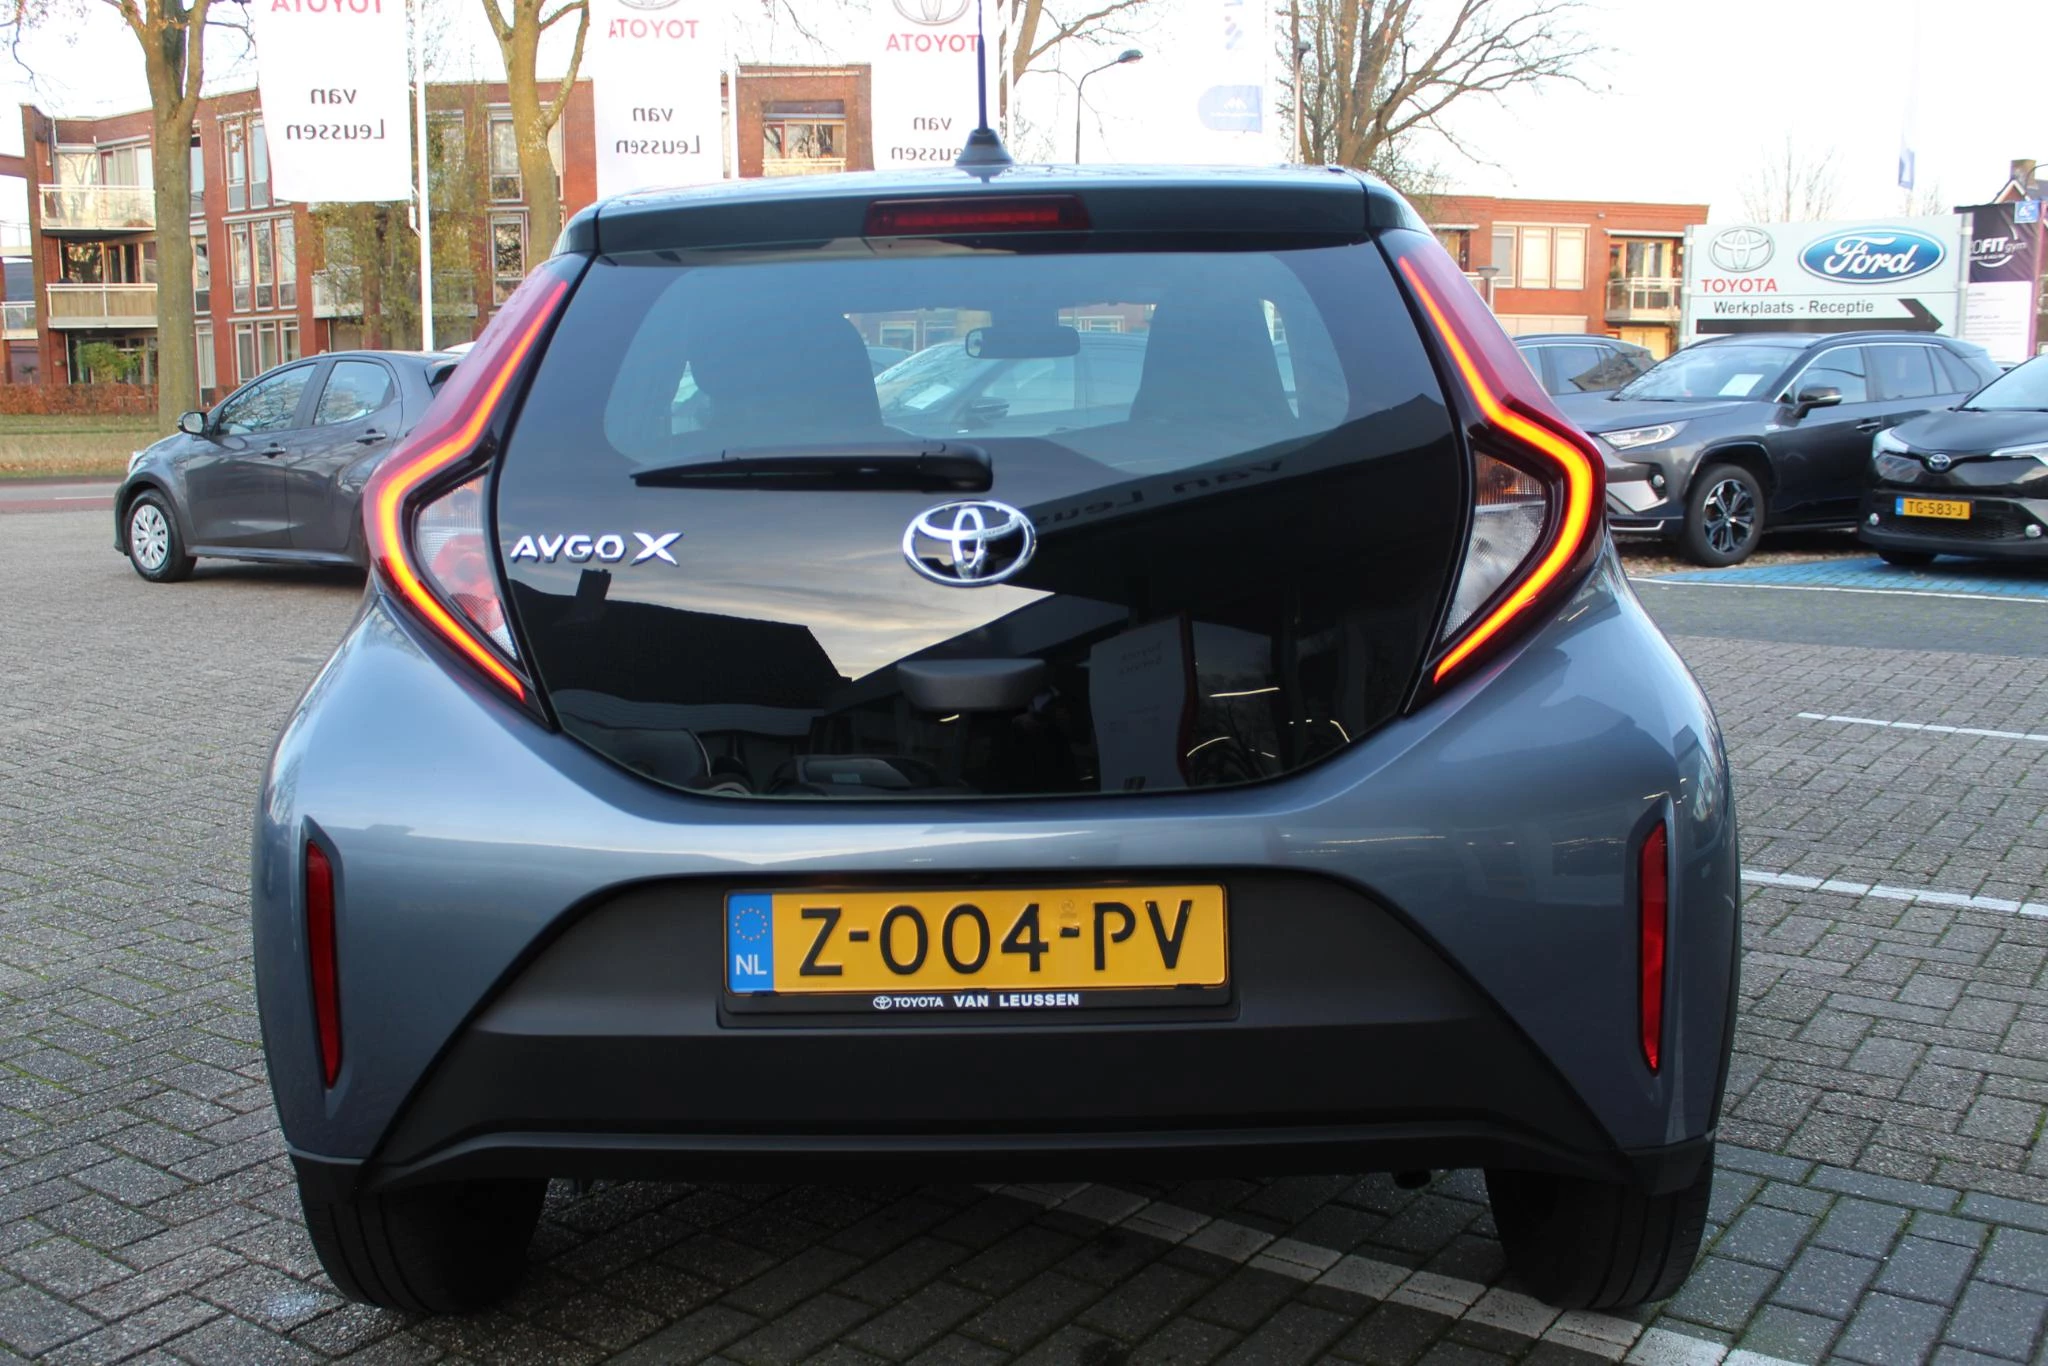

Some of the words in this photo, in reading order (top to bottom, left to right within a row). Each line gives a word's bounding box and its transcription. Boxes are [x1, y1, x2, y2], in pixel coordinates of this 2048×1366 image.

[1823, 235, 1920, 275] Ford
[1701, 278, 1778, 293] TOYOTA
[1713, 301, 1794, 314] Werkplaats
[1808, 300, 1874, 315] Receptie
[1908, 501, 1964, 516] TG-583-J
[630, 531, 683, 566] X
[799, 900, 1194, 977] Z-004-PV
[736, 954, 767, 975] NL
[893, 997, 944, 1008] TOYOTA
[953, 995, 989, 1008] VAN
[999, 993, 1080, 1007] LEUSSEN
